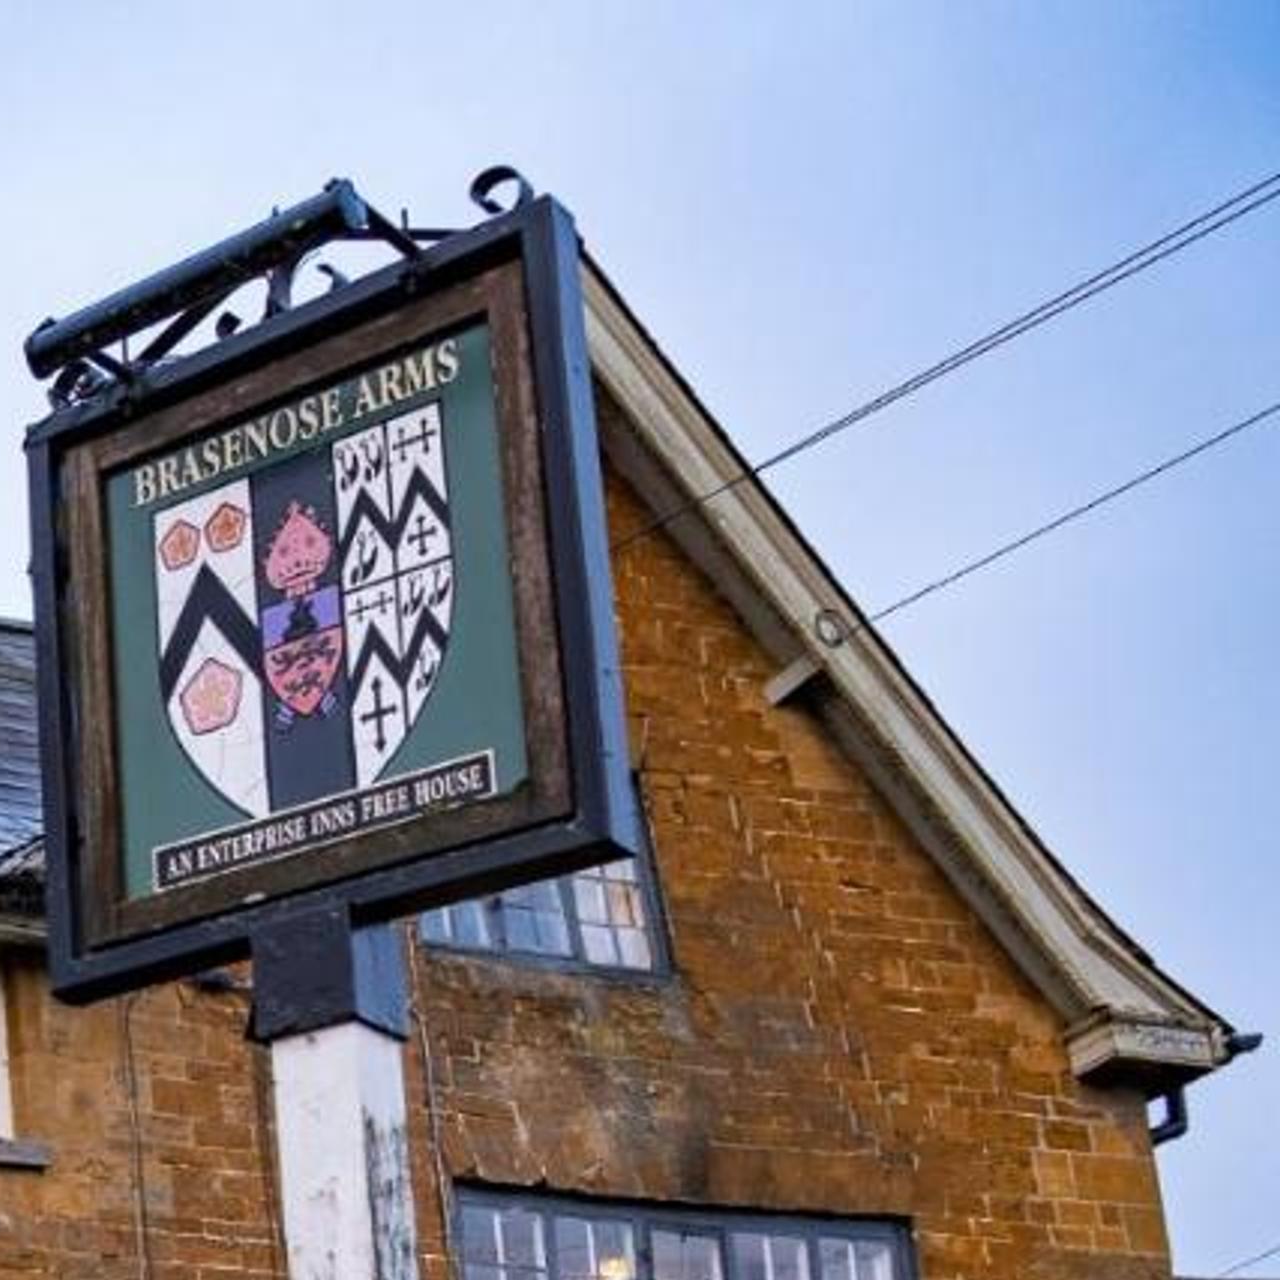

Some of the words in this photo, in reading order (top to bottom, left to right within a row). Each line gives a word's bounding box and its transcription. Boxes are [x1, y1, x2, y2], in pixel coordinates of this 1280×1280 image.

[133, 388, 343, 506] BRASENOSE
[351, 338, 459, 418] ARMS
[166, 850, 193, 880] AN
[197, 819, 307, 870] ENTERPRISE
[311, 801, 356, 836] INNS
[361, 786, 410, 823] FREE
[414, 763, 485, 806] HOUSE
